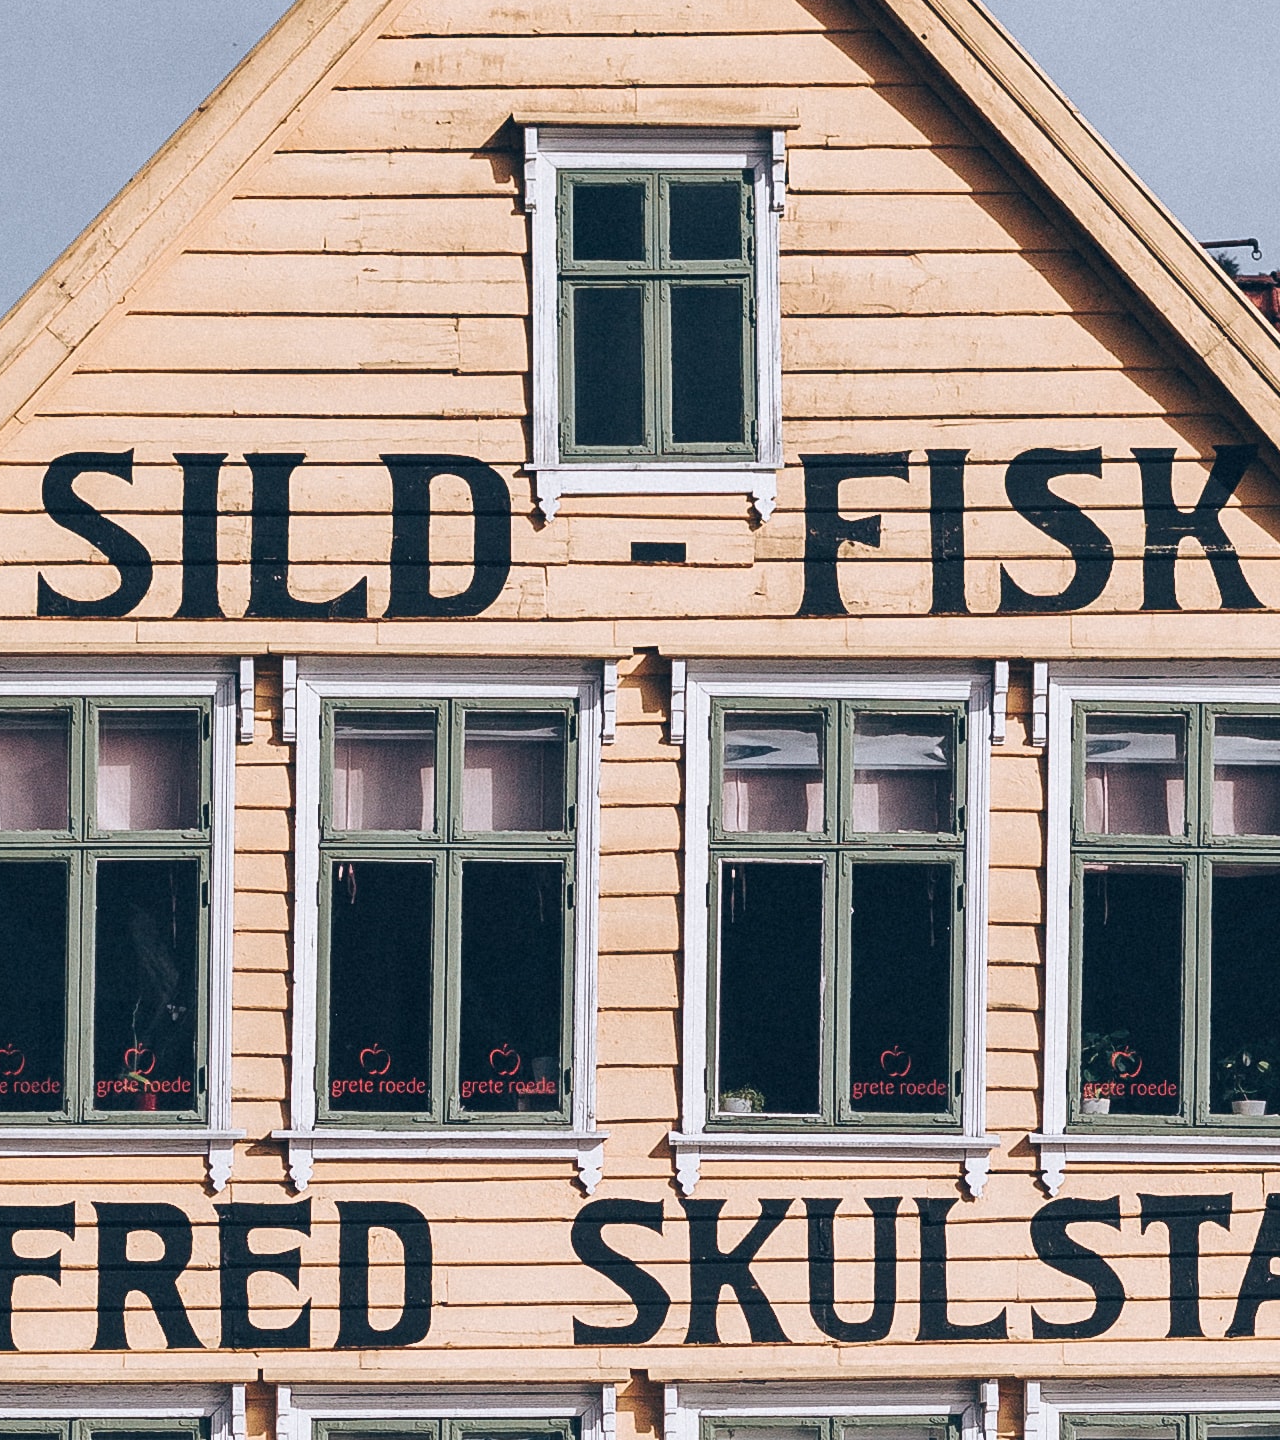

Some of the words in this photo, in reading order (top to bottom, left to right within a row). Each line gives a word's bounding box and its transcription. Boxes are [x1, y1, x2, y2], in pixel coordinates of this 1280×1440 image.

[37, 447, 513, 619] SILD
[795, 444, 1268, 617] FISK
[13, 1076, 61, 1093] roede
[96, 1078, 139, 1097] grete
[144, 1076, 192, 1093] roede
[331, 1078, 374, 1097] grete
[378, 1076, 426, 1093] roede
[461, 1078, 504, 1097] grete
[508, 1076, 557, 1093] roede
[852, 1081, 895, 1100] grete
[899, 1079, 947, 1096] roede
[1083, 1082, 1126, 1101] grete
[1130, 1080, 1178, 1097] roede
